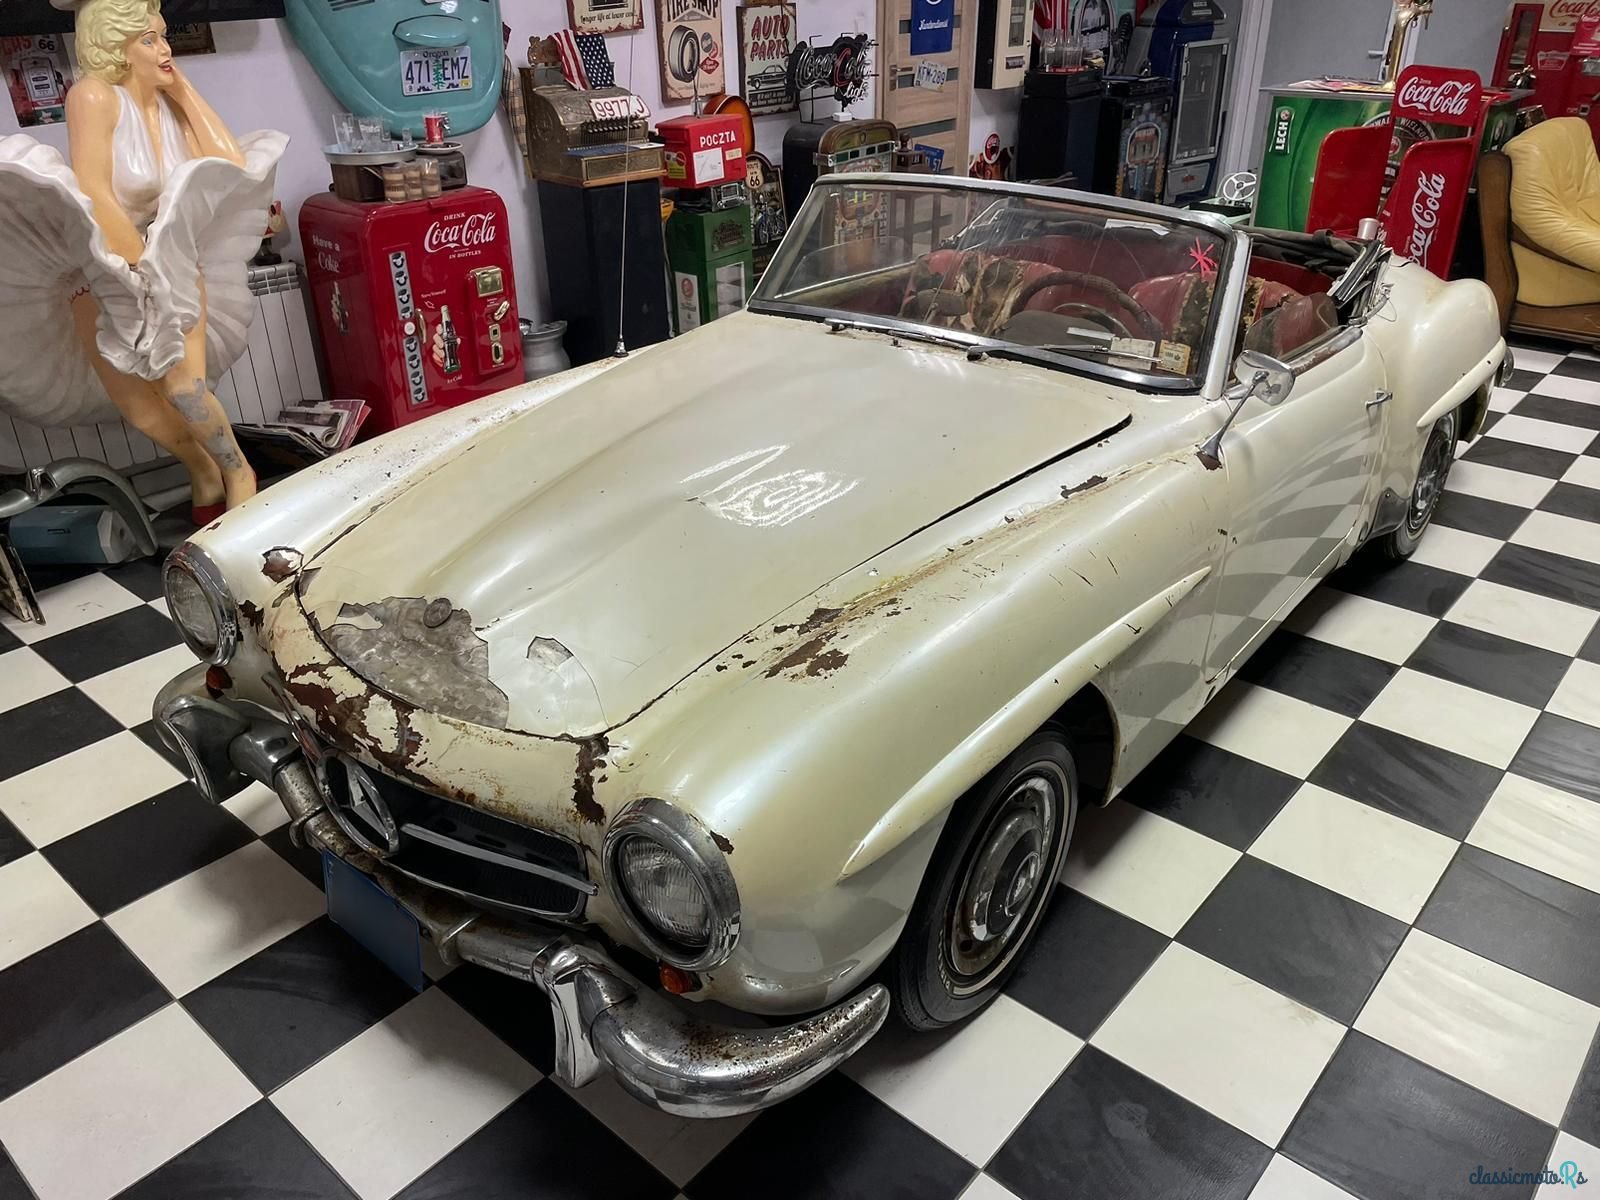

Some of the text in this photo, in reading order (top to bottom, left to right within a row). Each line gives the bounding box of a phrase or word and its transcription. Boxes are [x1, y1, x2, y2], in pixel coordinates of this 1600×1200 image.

[751, 14, 790, 41] AUTO
[38, 38, 56, 51] 66
[422, 50, 449, 58] Oregon
[750, 39, 790, 62] PARTS
[405, 56, 469, 85] 471 EMZ
[1398, 76, 1476, 116] Coca-Cola
[595, 100, 630, 118] 9977
[699, 130, 737, 149] POCZTA
[1275, 121, 1289, 151] LECH
[749, 175, 760, 187] 66
[443, 212, 466, 221] DRINK
[1408, 170, 1446, 268] oca-Cola
[312, 235, 333, 249] Have
[424, 212, 497, 253] Coca-Cola
[318, 252, 341, 273] Coke
[457, 249, 481, 259] BOTTLES
